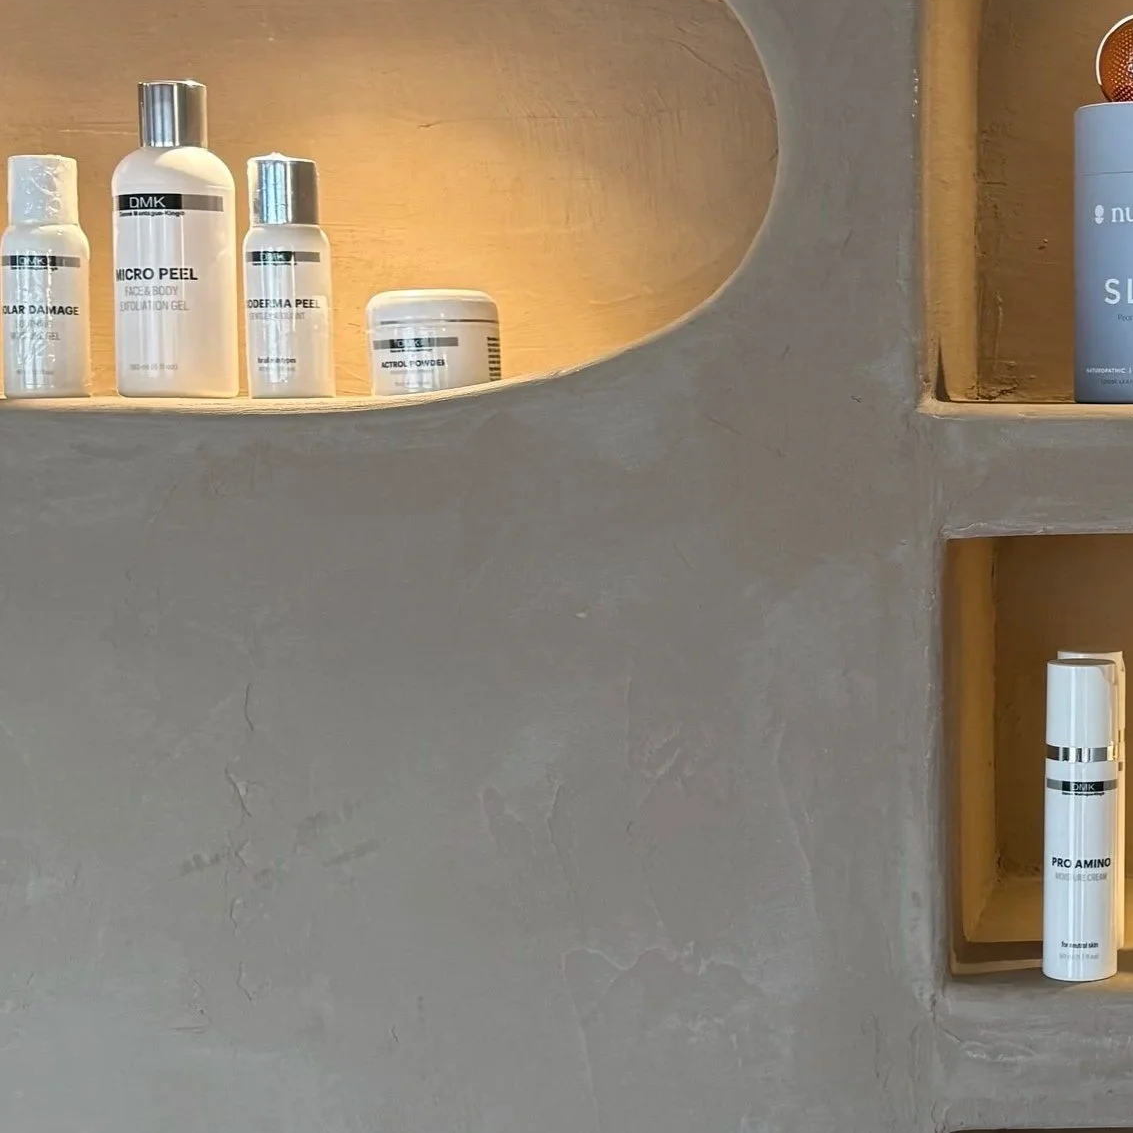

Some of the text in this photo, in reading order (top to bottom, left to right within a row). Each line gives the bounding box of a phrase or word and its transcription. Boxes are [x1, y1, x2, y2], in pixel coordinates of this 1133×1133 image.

[129, 196, 166, 208] DMK
[159, 268, 198, 280] PEEL
[3, 305, 24, 315] OLAR
[1052, 857, 1111, 868] PRO AMINO
